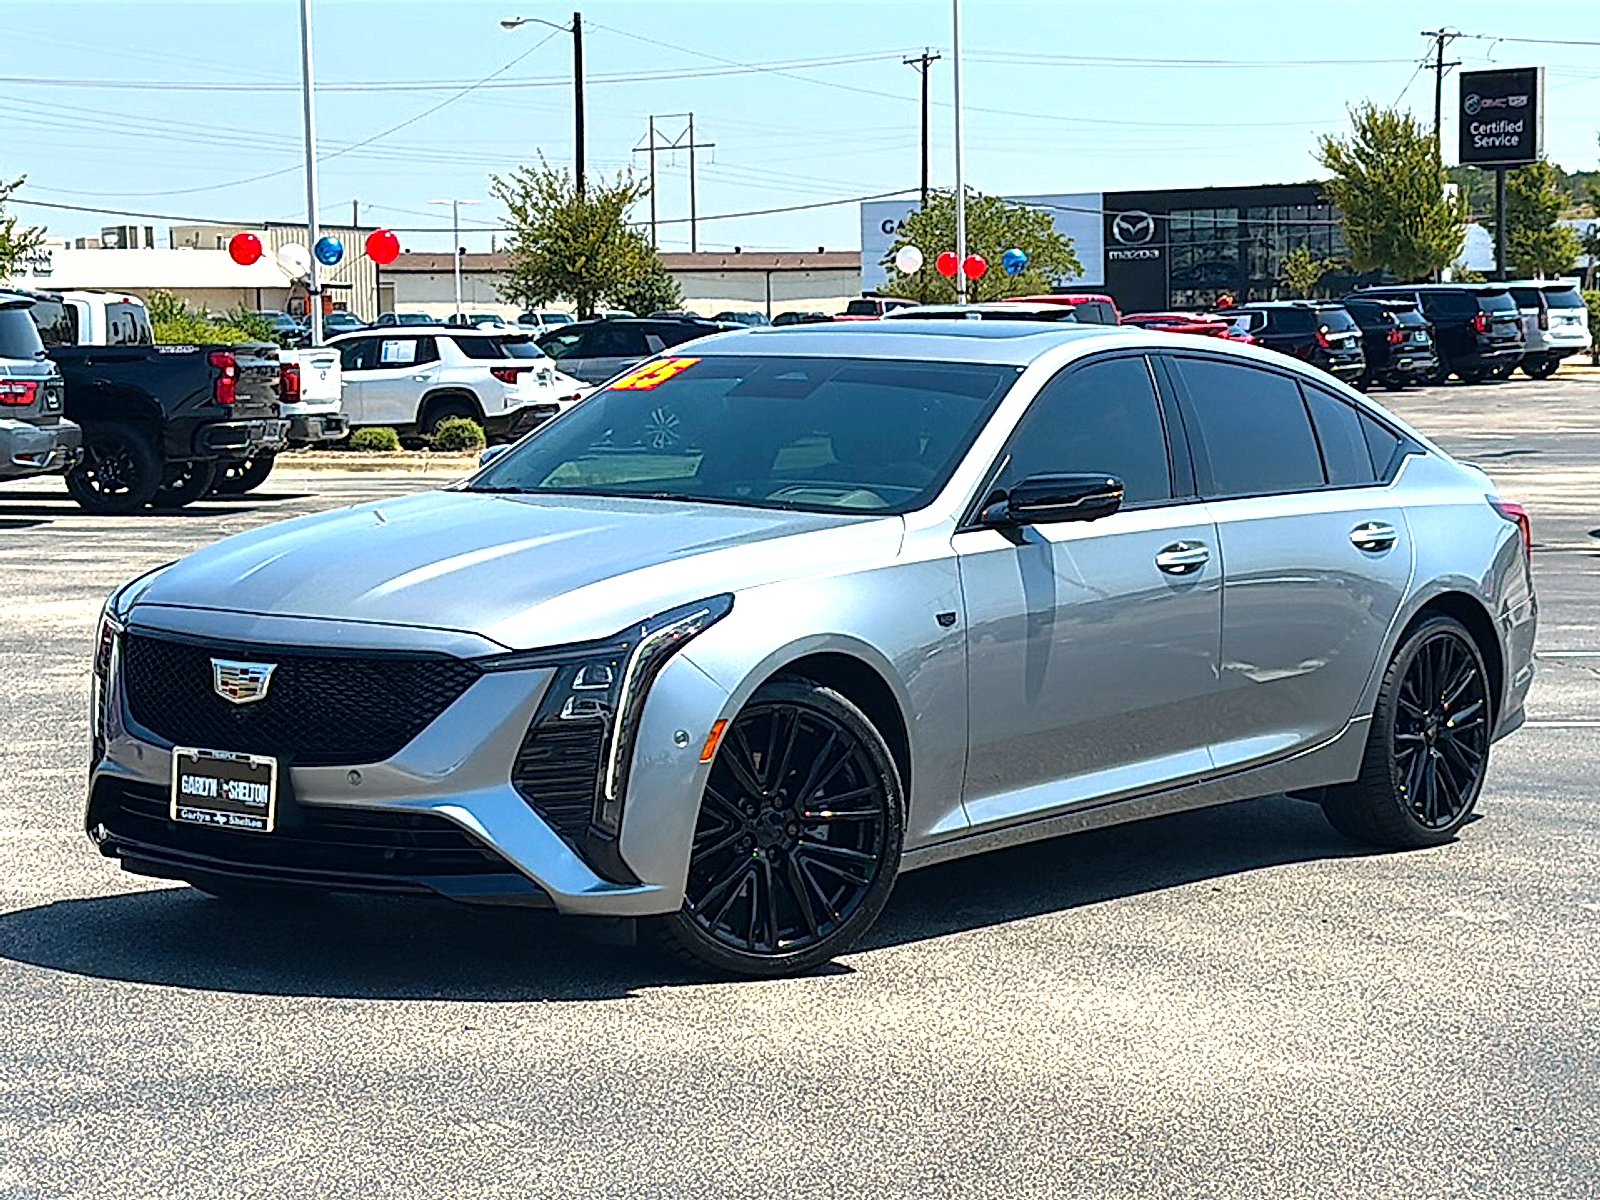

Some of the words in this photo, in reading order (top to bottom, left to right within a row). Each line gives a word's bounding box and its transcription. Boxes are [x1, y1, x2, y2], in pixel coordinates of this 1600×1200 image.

[1470, 120, 1523, 135] Certified
[1474, 134, 1519, 148] Service
[181, 775, 217, 797] GARLYN
[229, 780, 268, 803] SHELTON
